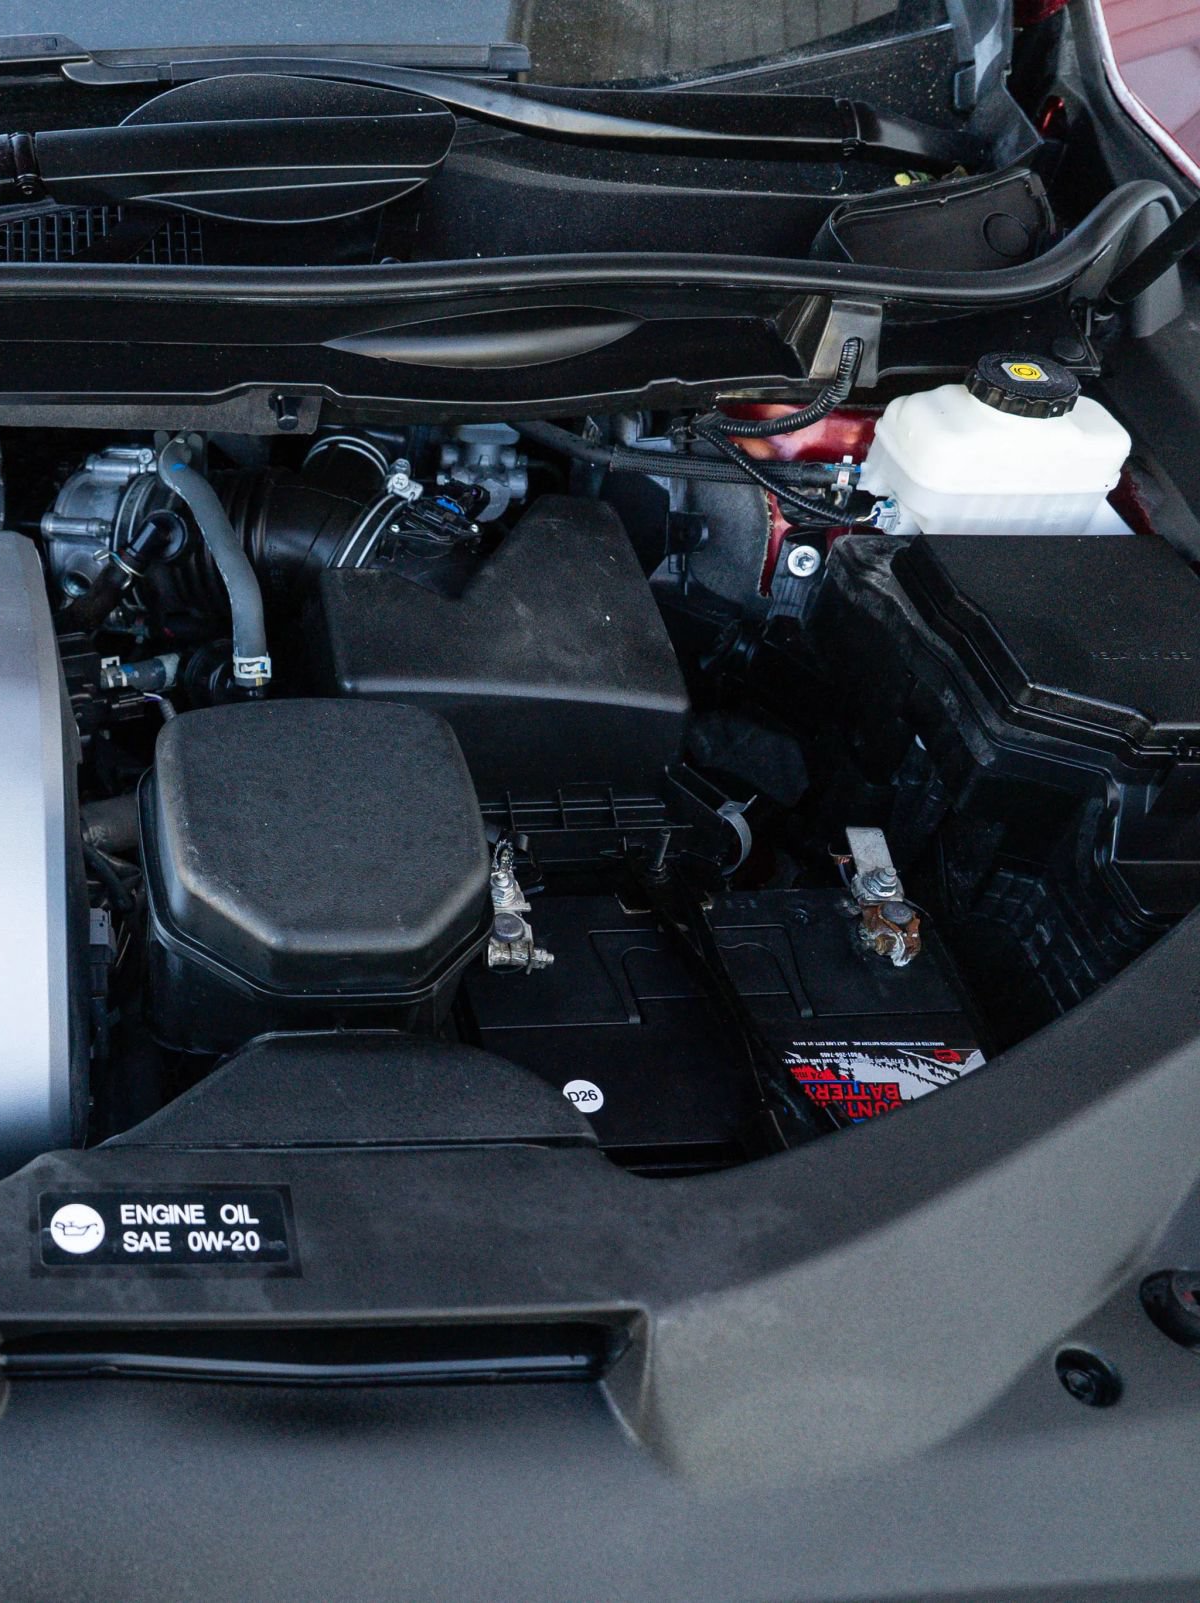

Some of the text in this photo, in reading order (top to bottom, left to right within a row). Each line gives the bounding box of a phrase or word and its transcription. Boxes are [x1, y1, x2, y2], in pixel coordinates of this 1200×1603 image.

[566, 1089, 599, 1103] D26
[120, 1204, 260, 1225] ENGINE OIL
[123, 1230, 260, 1252] SAE 0W-20
